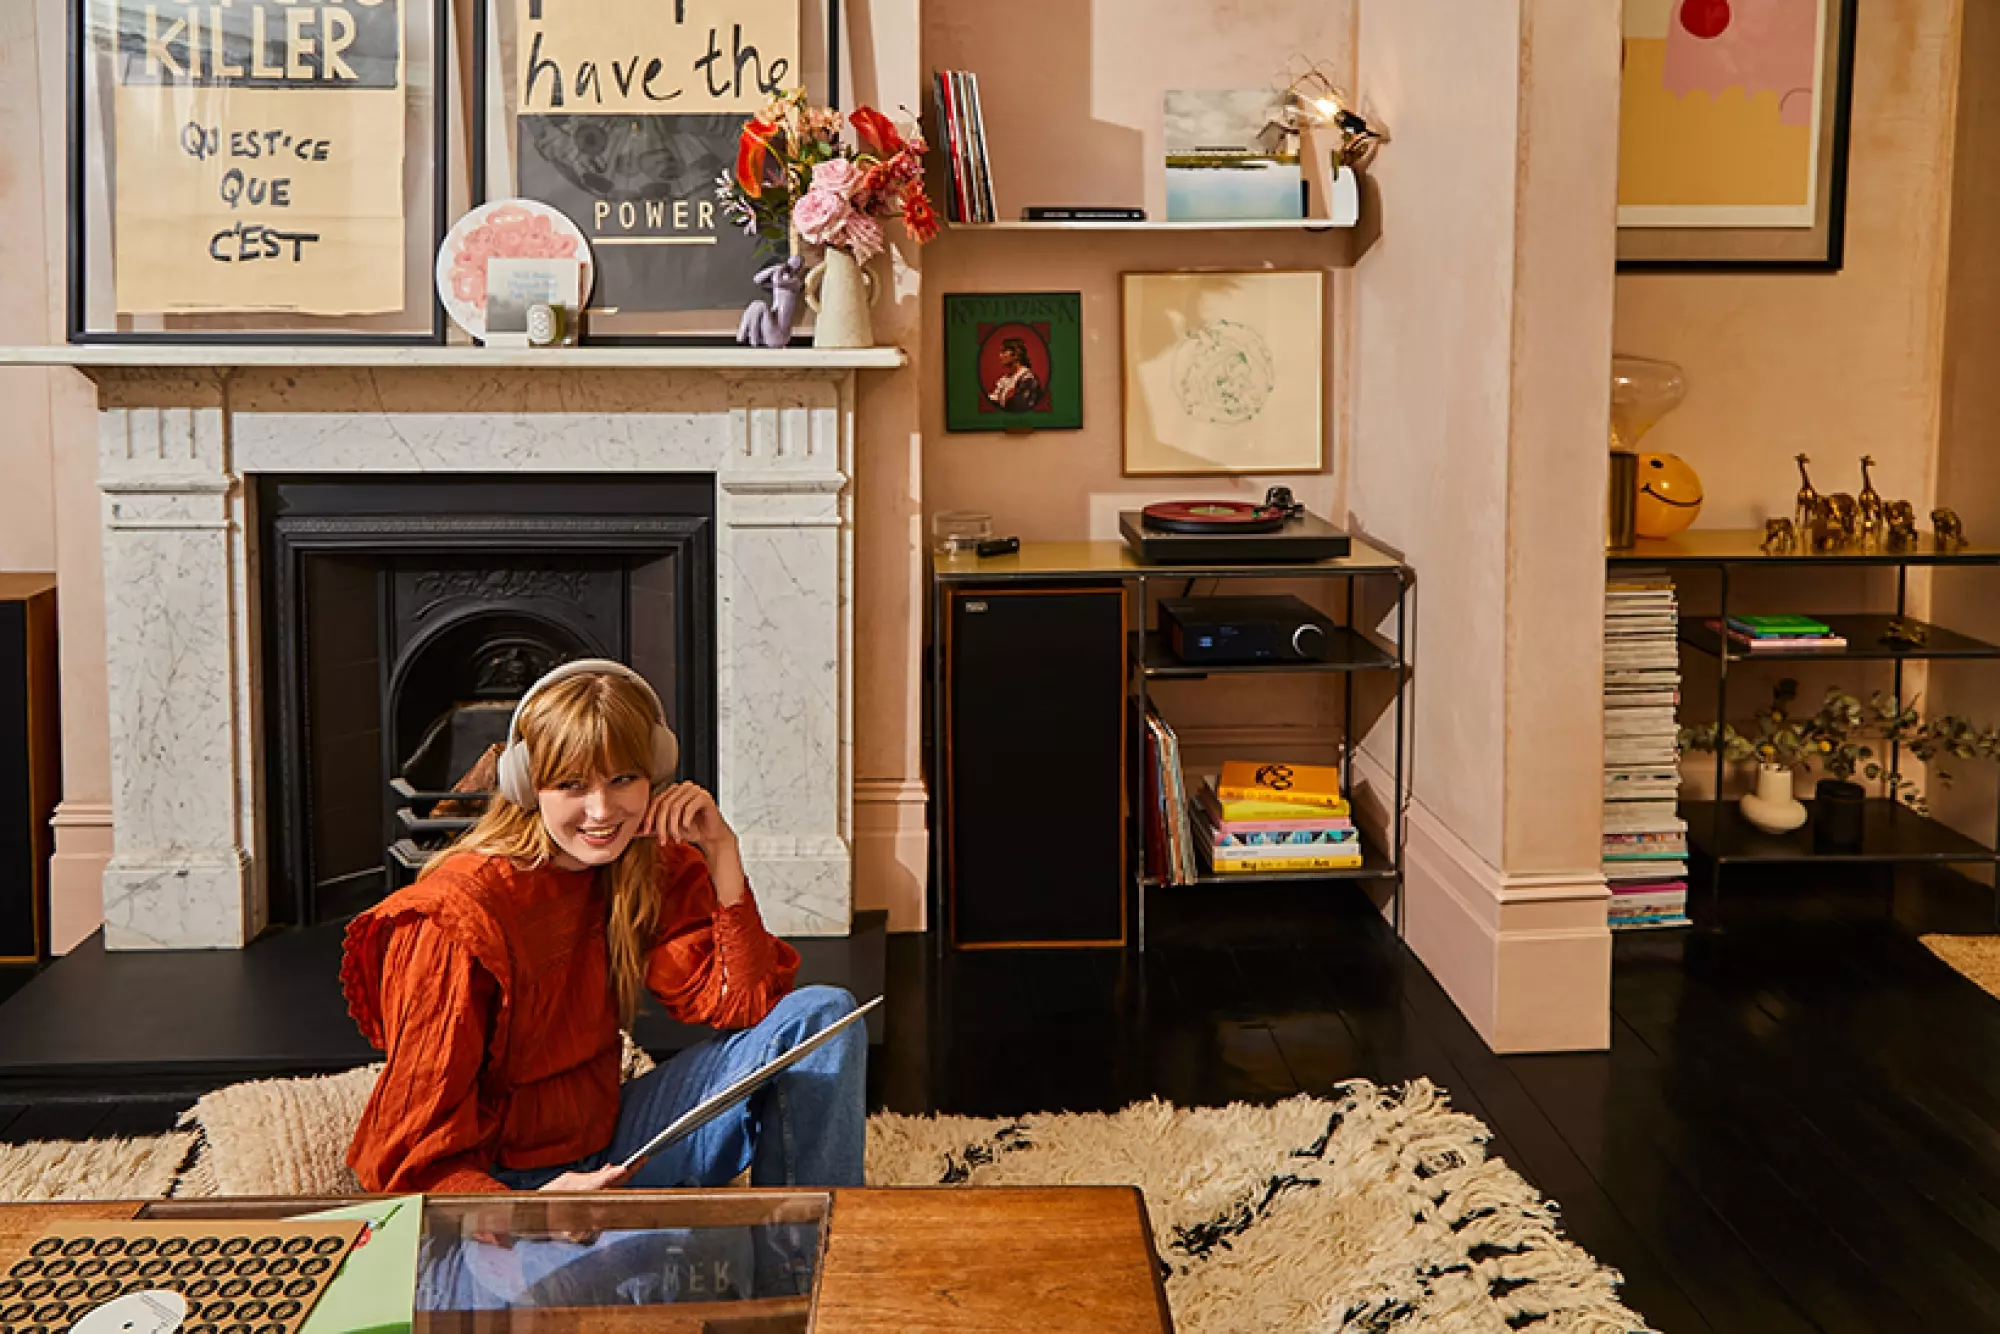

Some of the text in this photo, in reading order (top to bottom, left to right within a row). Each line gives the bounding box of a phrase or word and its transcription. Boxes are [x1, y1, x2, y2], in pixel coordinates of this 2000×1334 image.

[145, 5, 359, 79] KILLER
[524, 23, 789, 107] have the
[221, 167, 291, 209] QUE
[594, 200, 717, 230] POWER
[209, 220, 319, 262] C'EST
